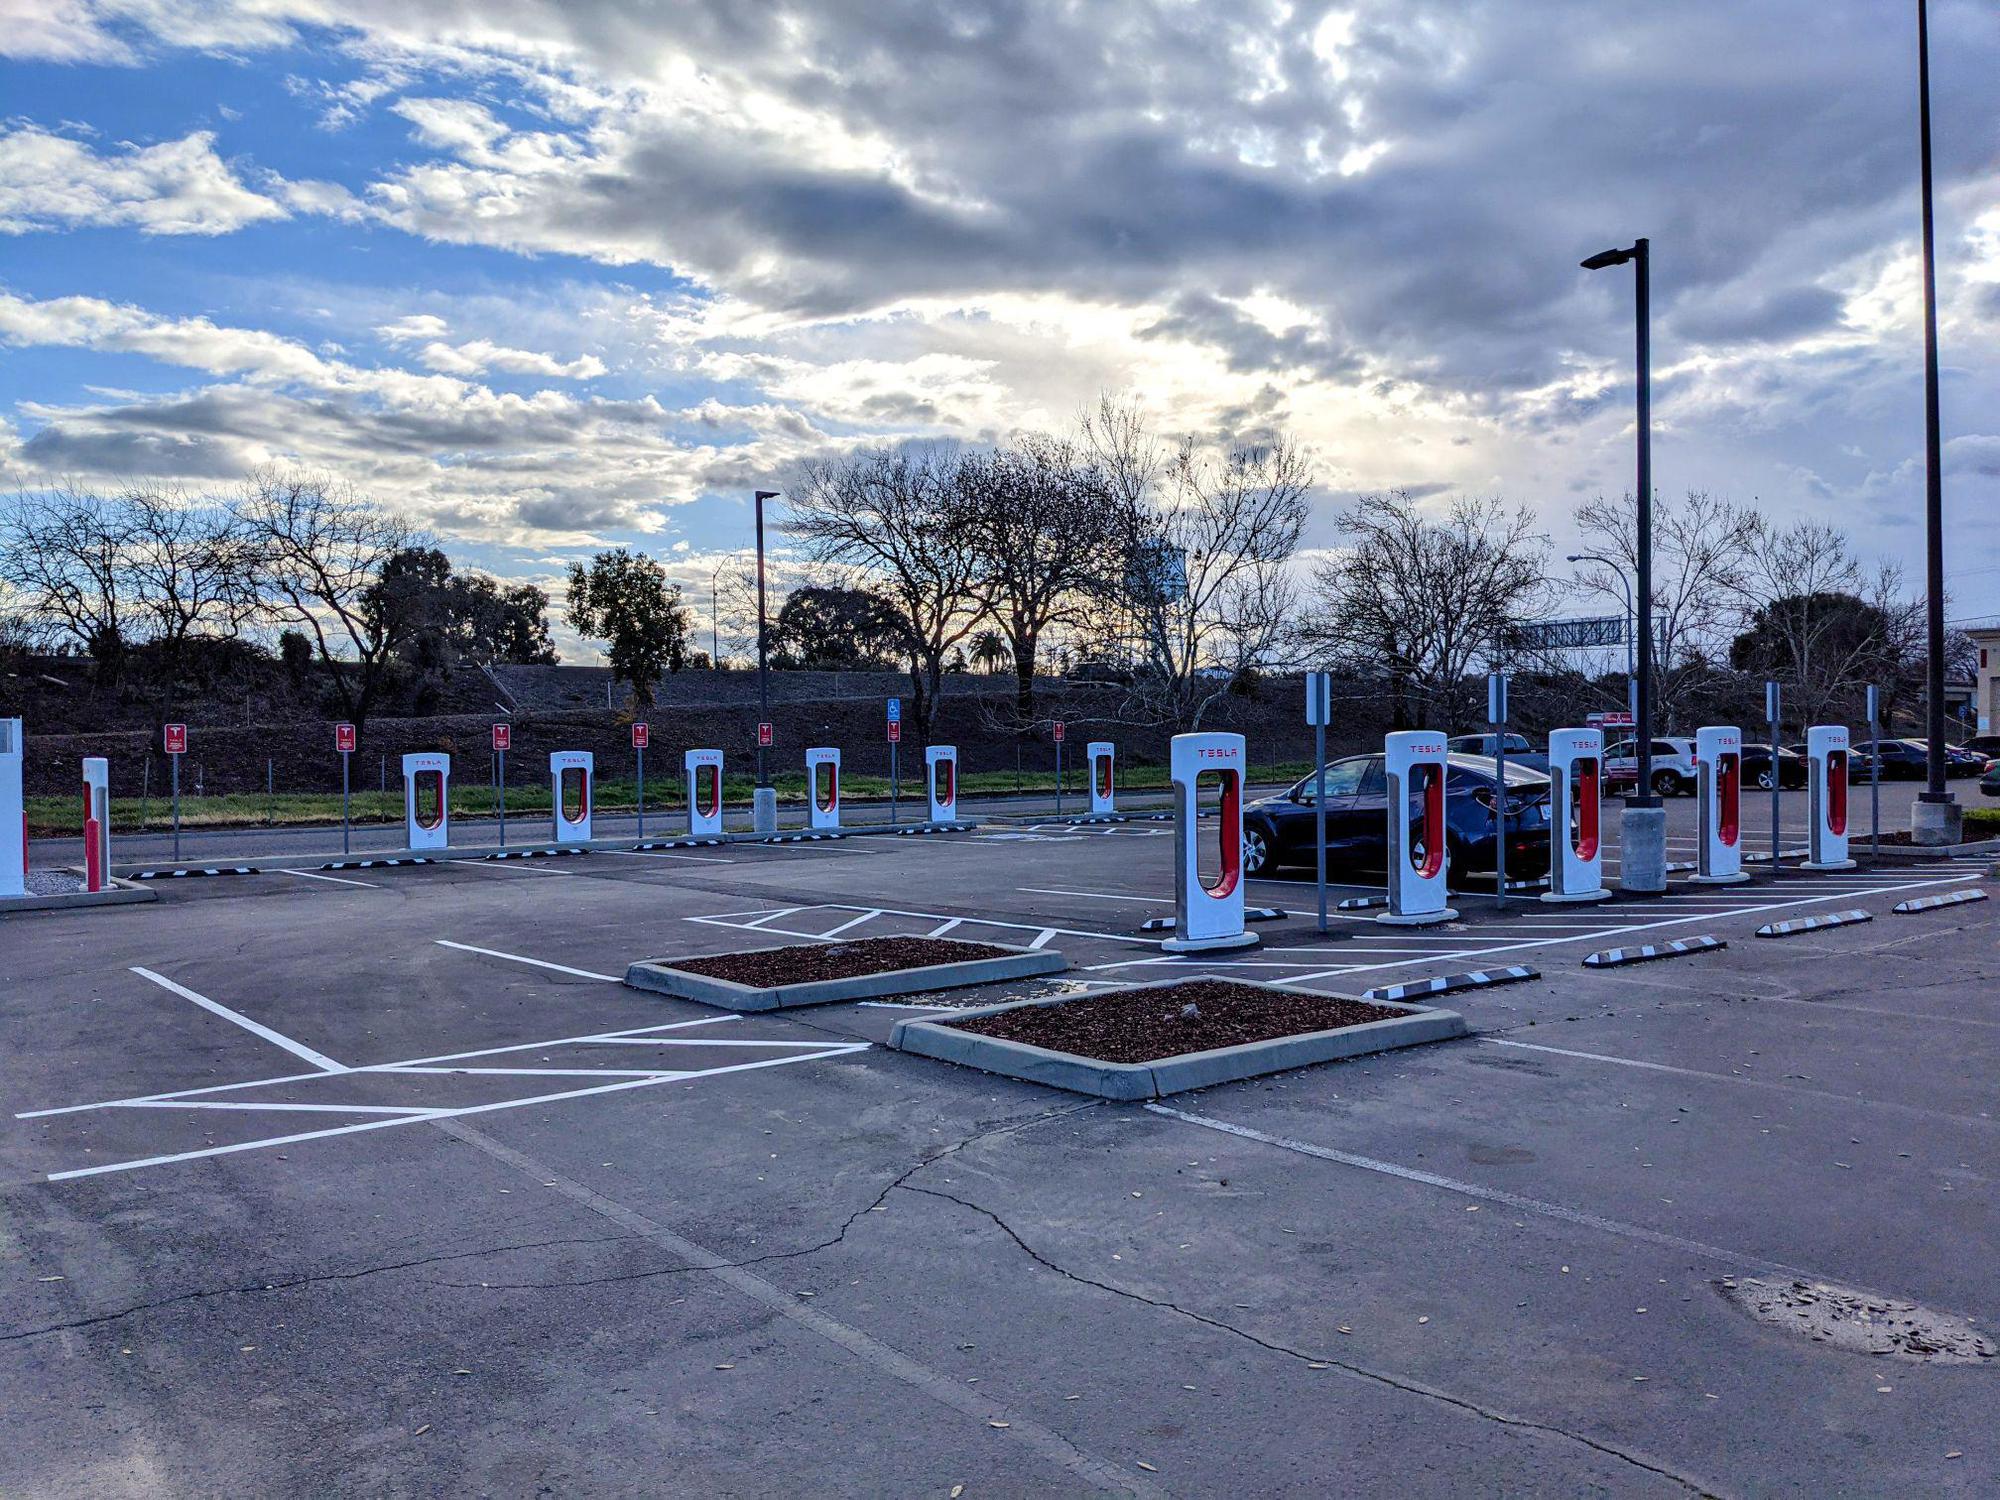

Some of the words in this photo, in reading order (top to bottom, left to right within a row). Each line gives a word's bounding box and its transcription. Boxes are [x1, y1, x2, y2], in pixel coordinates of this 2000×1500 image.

[1410, 745, 1442, 753] TESLA
[1572, 741, 1598, 749] TESLA
[1198, 749, 1238, 758] TESLA
